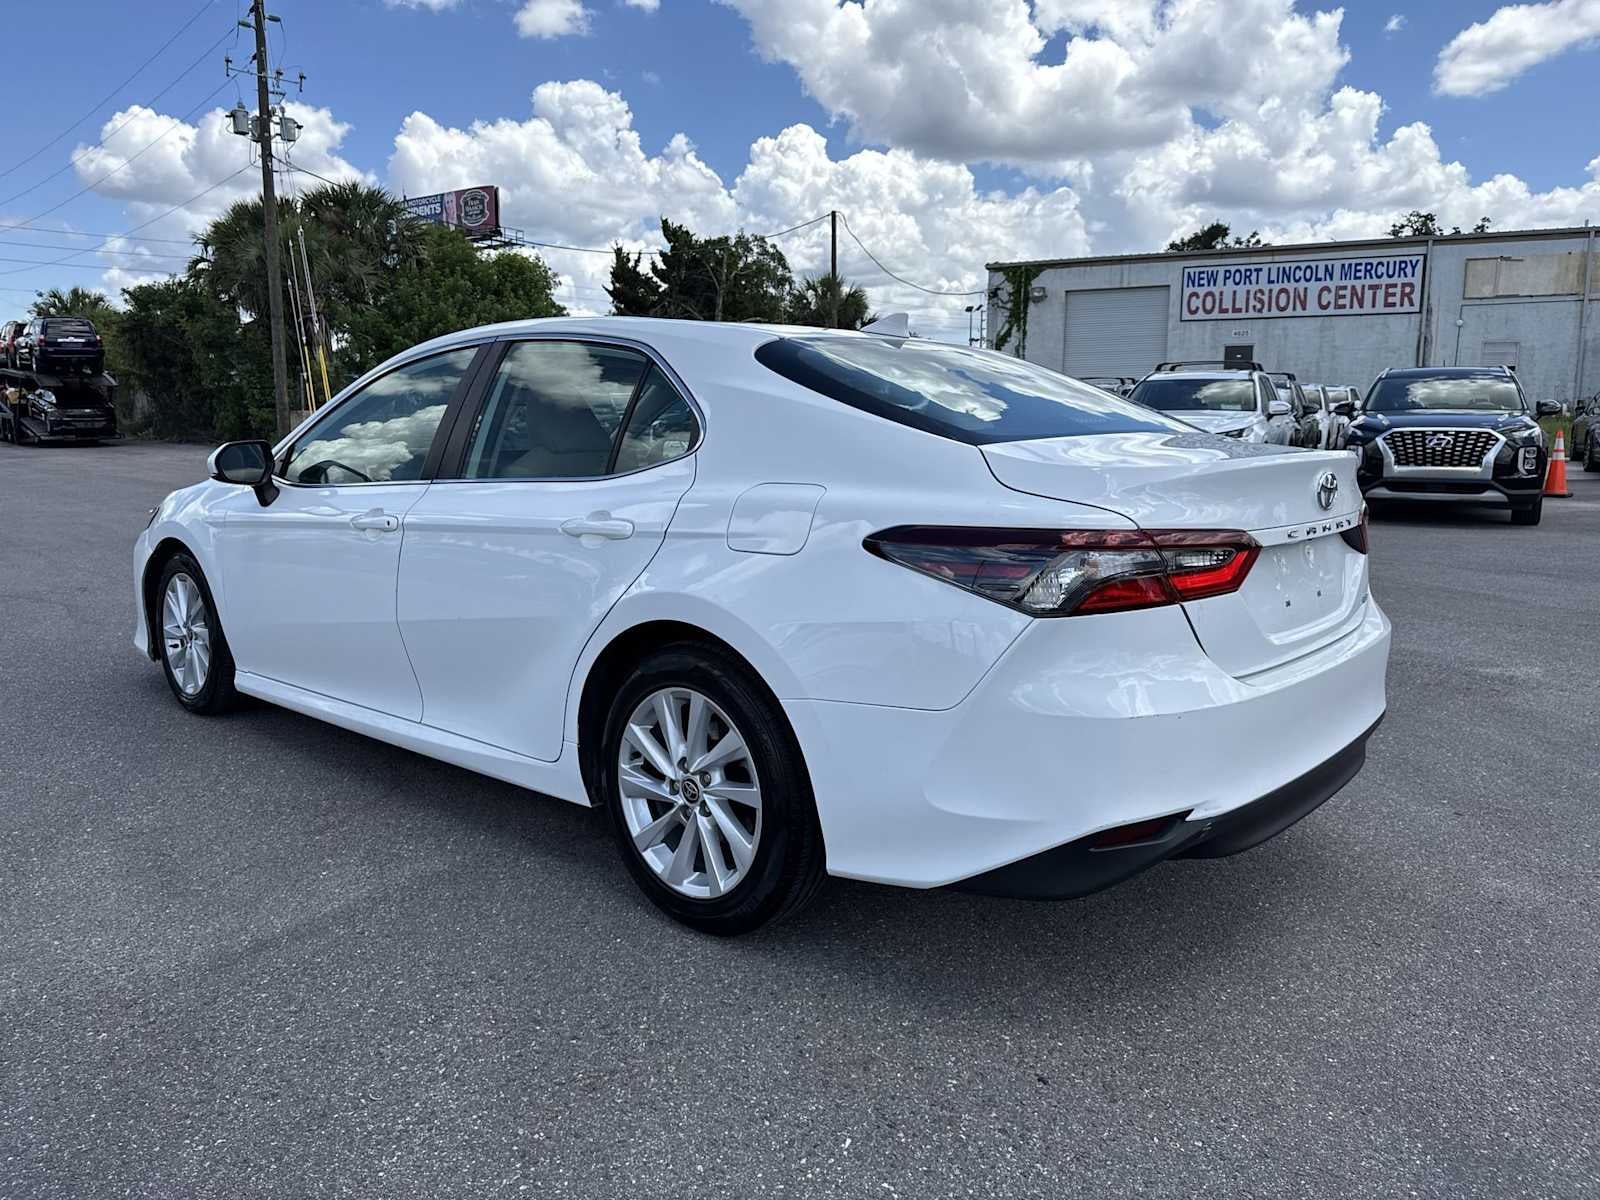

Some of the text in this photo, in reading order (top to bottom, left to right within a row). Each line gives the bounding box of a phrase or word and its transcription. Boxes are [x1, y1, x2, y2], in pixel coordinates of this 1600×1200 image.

[1186, 259, 1420, 288] NEW PORT LINCOLN MERCURY
[1186, 282, 1415, 316] COLLISION CENTER
[1287, 519, 1352, 538] CAMRY
